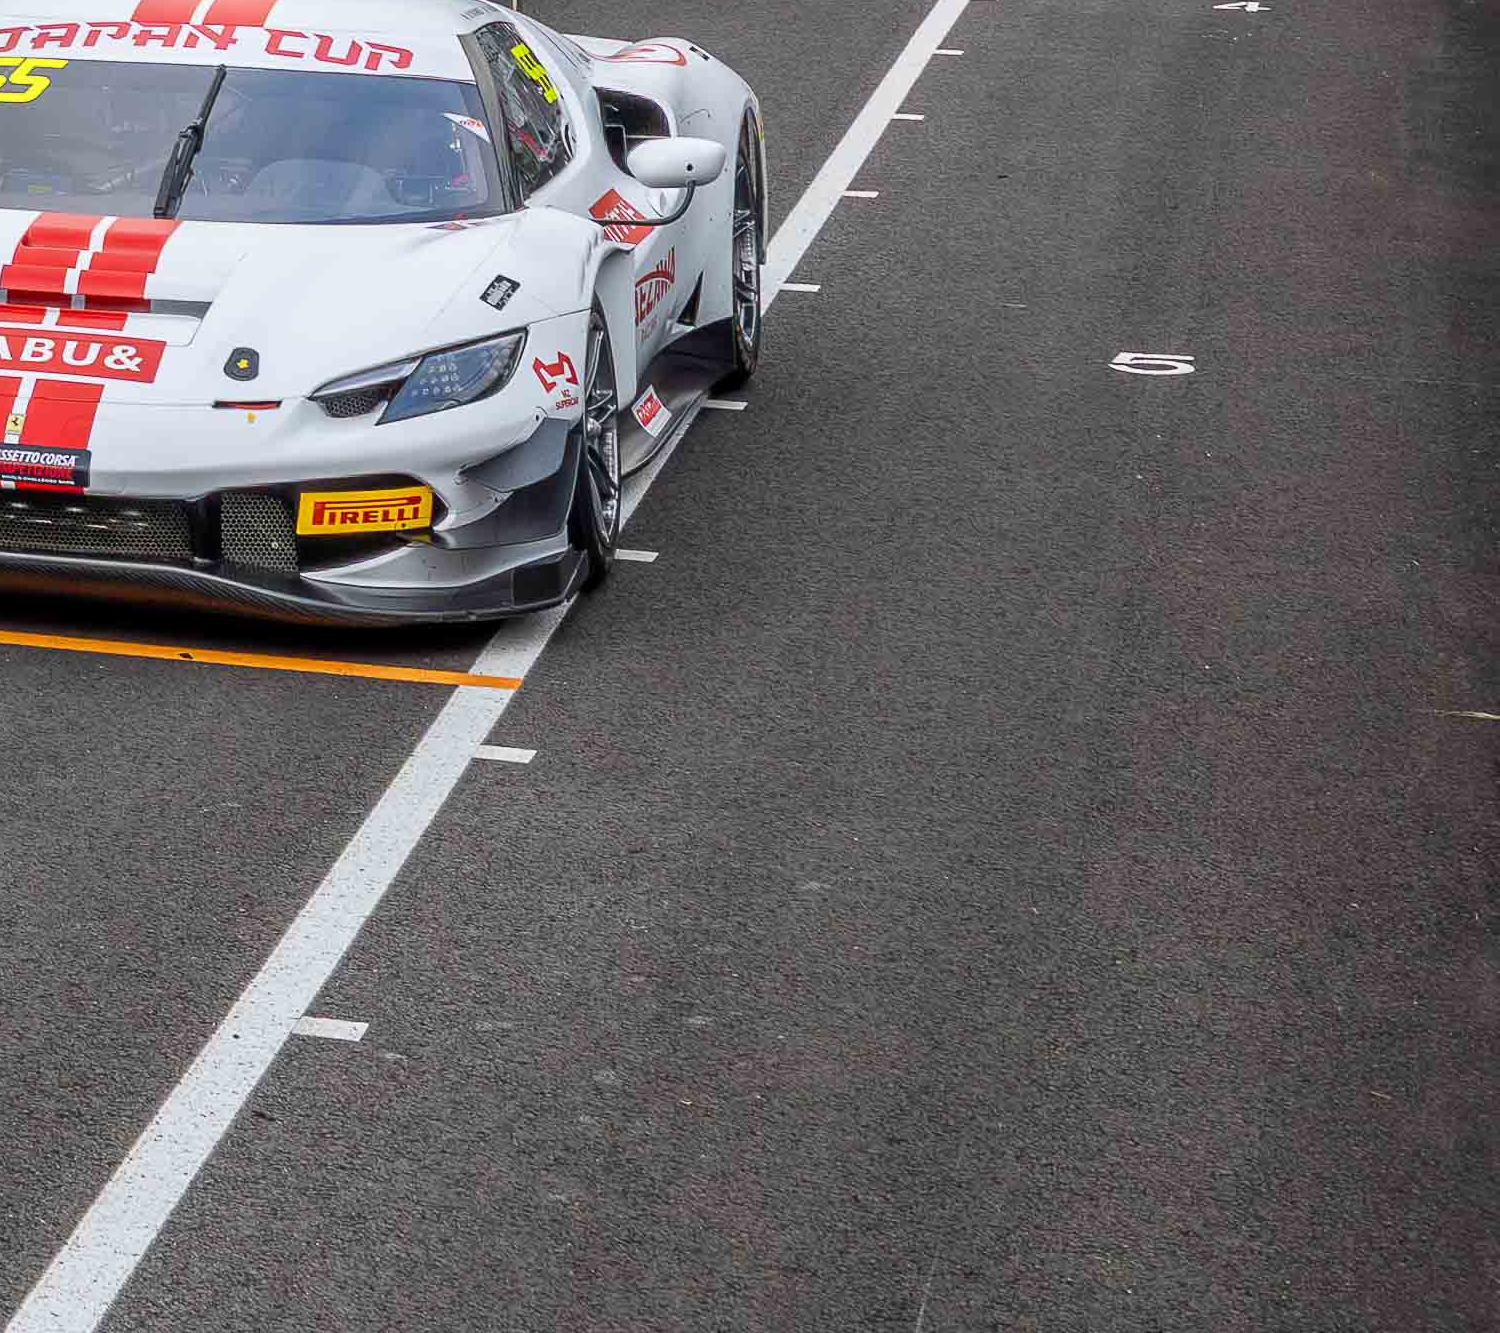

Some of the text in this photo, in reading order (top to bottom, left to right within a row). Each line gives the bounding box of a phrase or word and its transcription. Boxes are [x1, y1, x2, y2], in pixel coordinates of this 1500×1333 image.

[261, 26, 415, 72] CUP
[1108, 351, 1197, 376] 5
[39, 452, 77, 467] CORSA
[312, 495, 423, 526] PIRELLI
